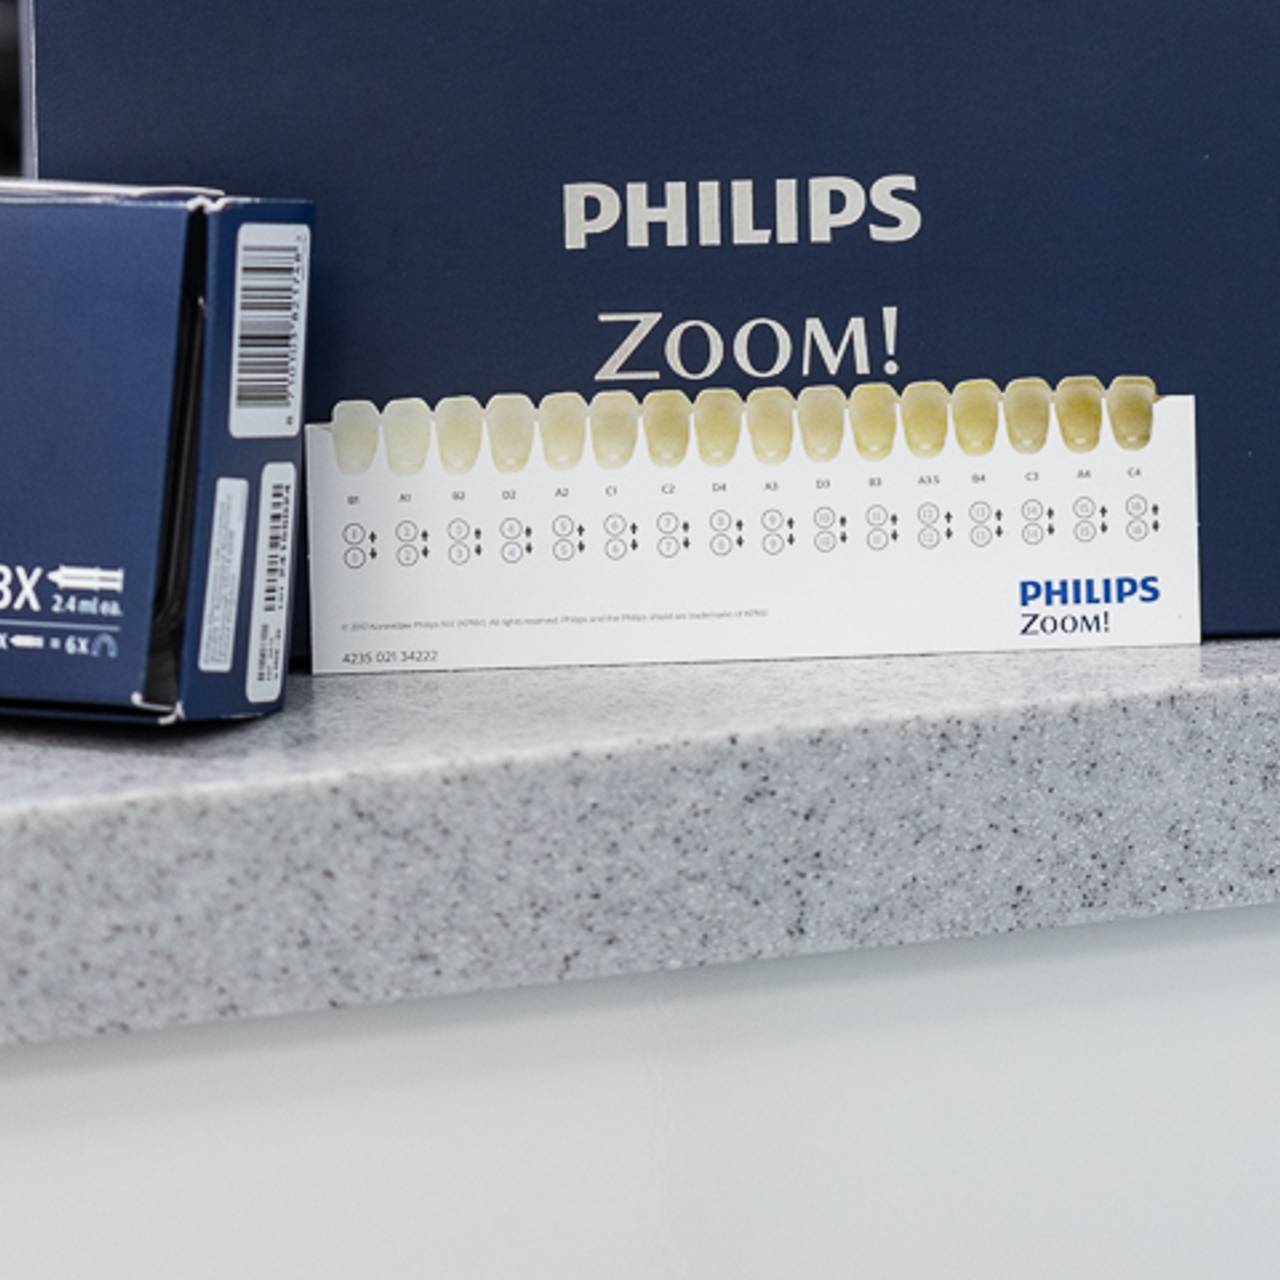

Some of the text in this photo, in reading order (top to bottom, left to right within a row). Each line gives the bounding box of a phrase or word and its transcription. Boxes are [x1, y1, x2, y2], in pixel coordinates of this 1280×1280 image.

[563, 174, 923, 250] PHILIPS
[594, 306, 900, 381] ZOOM!
[554, 487, 571, 499] A2
[603, 485, 619, 497] C1
[659, 483, 678, 495] C2
[709, 482, 728, 493] D4
[814, 479, 832, 490] D3
[1022, 471, 1041, 482] C3
[1019, 576, 1161, 607] PHILIPS
[1019, 611, 1110, 635] ZOOM!
[65, 634, 89, 654] 6X
[341, 650, 373, 664] 4235
[400, 649, 439, 663] 34222
